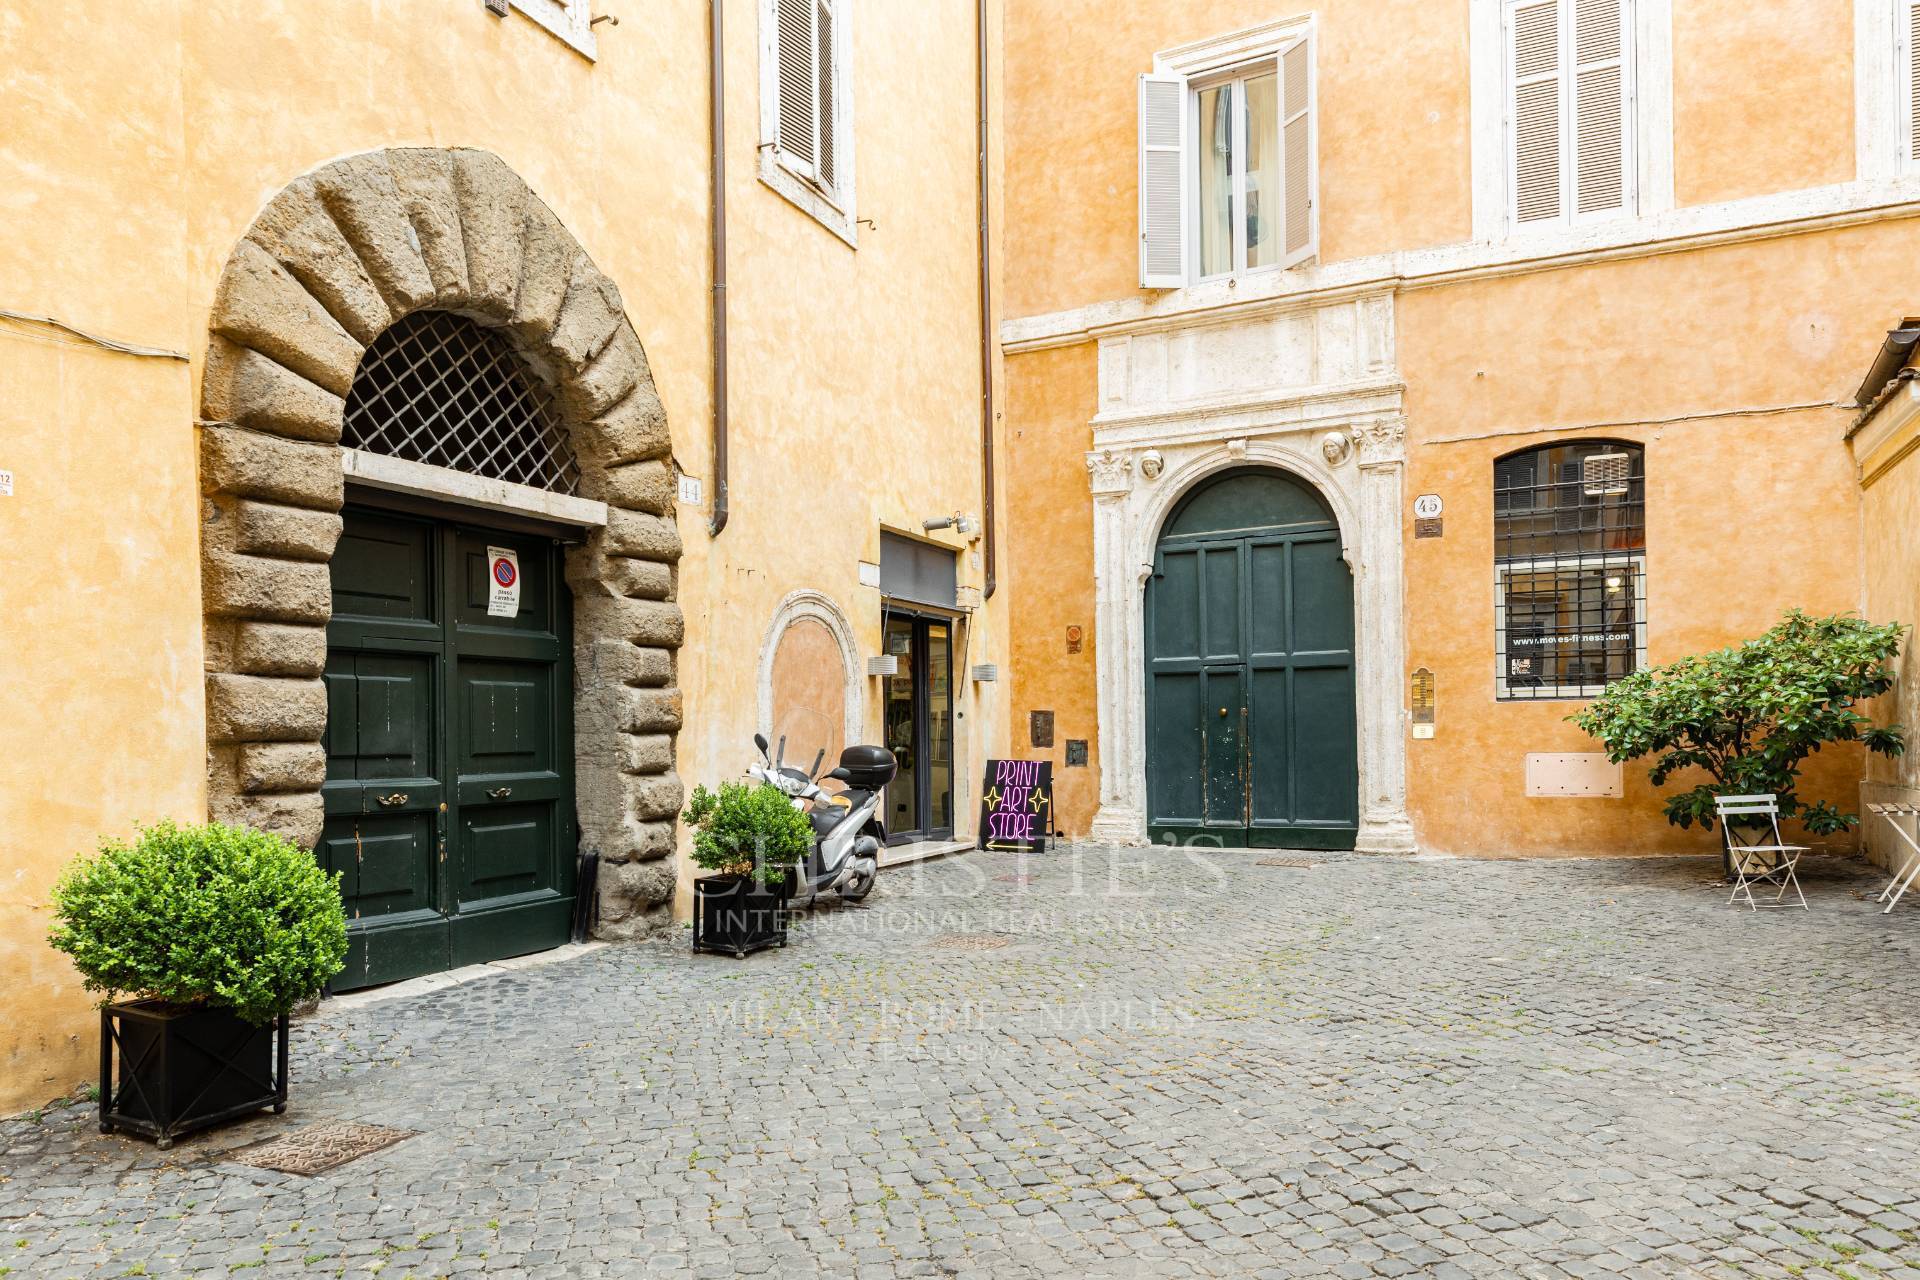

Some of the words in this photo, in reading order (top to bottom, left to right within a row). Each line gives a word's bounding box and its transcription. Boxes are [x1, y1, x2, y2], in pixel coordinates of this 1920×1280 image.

[1418, 497, 1438, 512] 45
[996, 760, 1043, 786] PRINT
[1000, 786, 1032, 812] ART
[989, 813, 1037, 841] STORE
